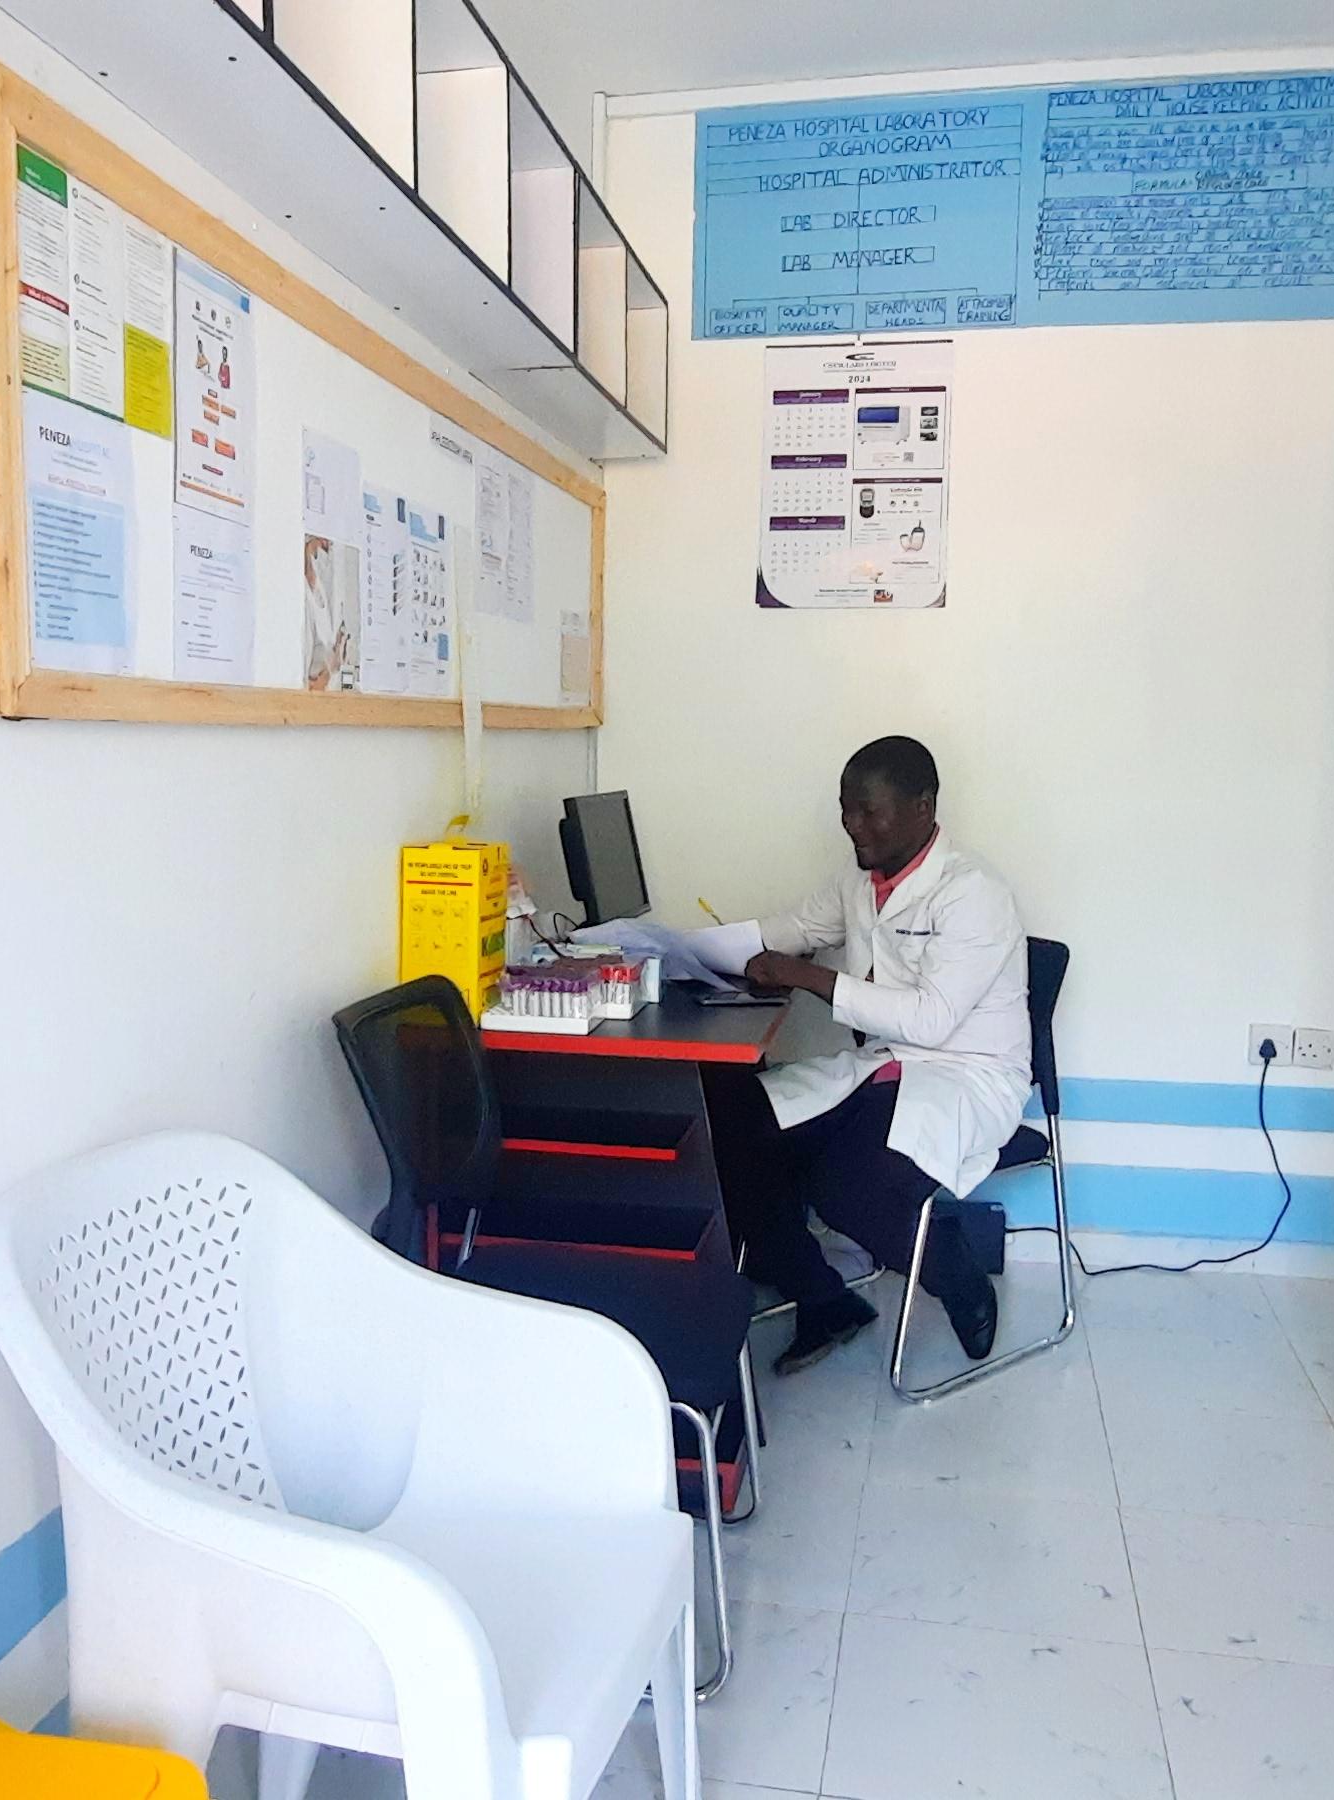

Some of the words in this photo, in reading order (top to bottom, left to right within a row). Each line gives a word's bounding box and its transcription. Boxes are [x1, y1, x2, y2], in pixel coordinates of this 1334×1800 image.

[1049, 90, 1096, 106] PENEZA
[1105, 86, 1171, 103] HOSPITAL
[1115, 102, 1152, 118] DAILY
[728, 126, 786, 143] PENEZA
[794, 116, 868, 138] HOSPITAL
[875, 109, 990, 131] LABORATORY
[818, 134, 952, 158] ORGANOGRAM
[759, 169, 851, 192] HOSPITAL
[858, 158, 1008, 185] ADMINISTRATOR
[781, 214, 812, 231] LAB
[833, 206, 921, 229] DIRECTOR
[781, 254, 812, 272] LAB
[832, 247, 917, 270] MANAGER
[782, 304, 841, 317] QUALITY
[714, 323, 763, 335] OFFICER
[777, 321, 839, 332] MANAGER
[39, 425, 72, 447] PENEZA
[190, 545, 213, 559] PENEZA
